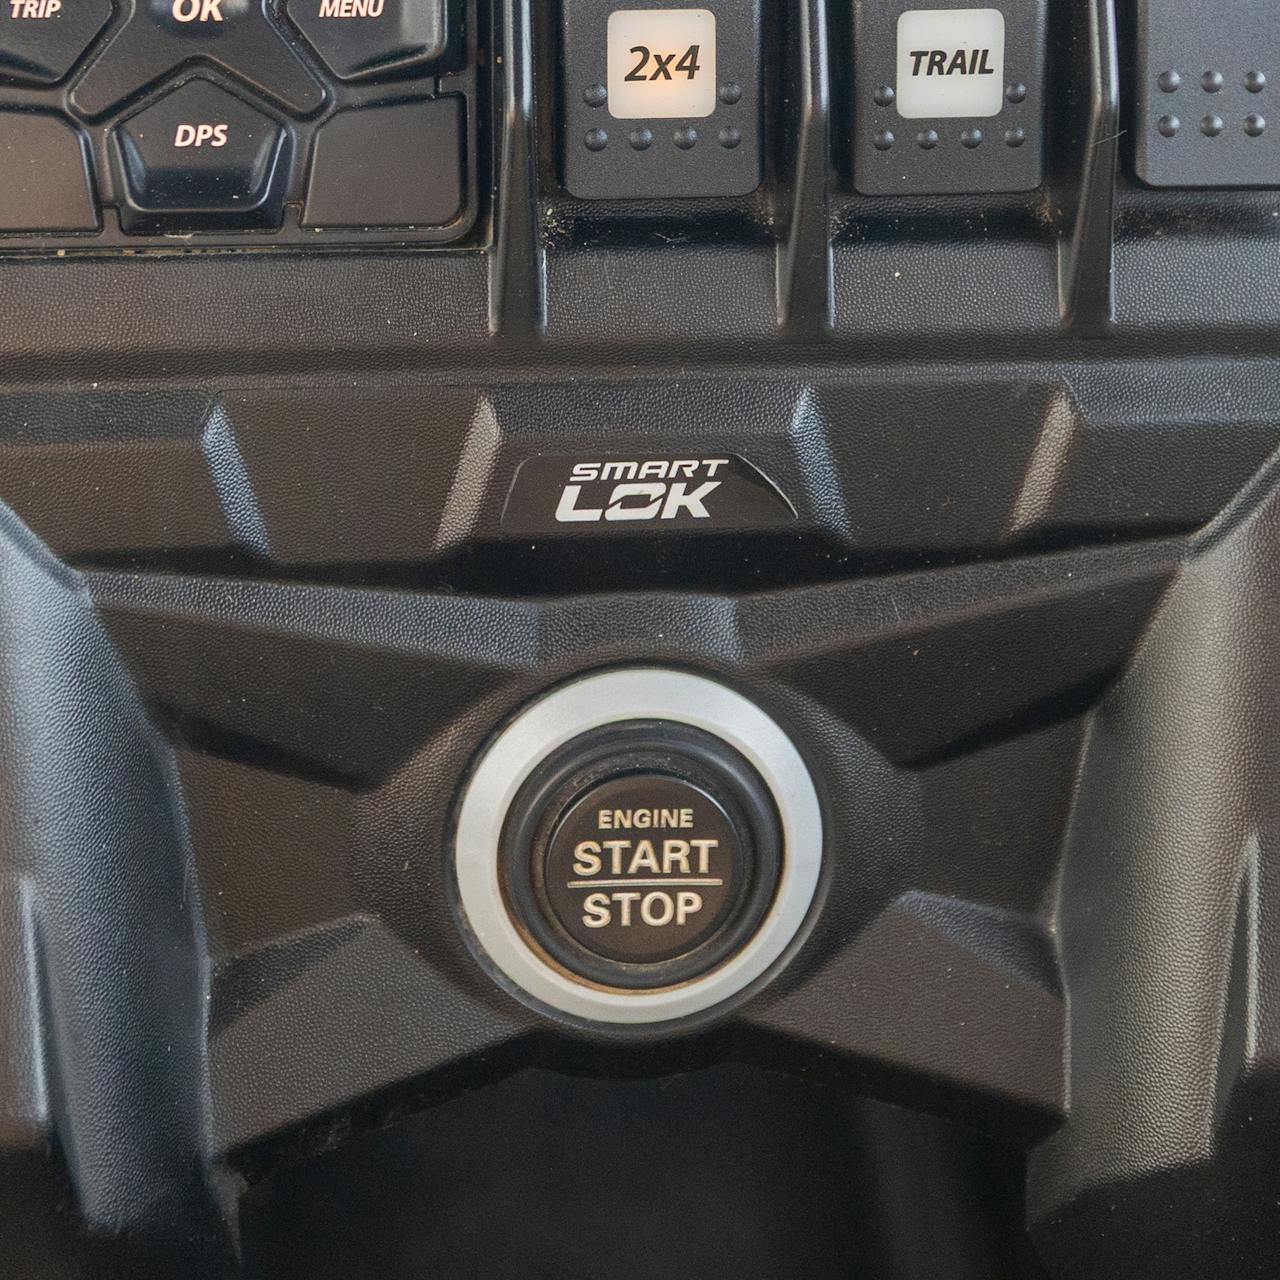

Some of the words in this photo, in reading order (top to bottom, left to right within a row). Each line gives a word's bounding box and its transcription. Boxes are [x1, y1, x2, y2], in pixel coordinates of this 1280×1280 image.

[10, 0, 61, 18] TRIP
[624, 45, 701, 83] 2x4
[909, 50, 995, 76] TRAIL
[174, 125, 228, 147] DPS
[569, 459, 729, 482] SMART
[555, 481, 722, 521] LOK
[598, 809, 694, 829] ENGINE
[573, 840, 718, 876] START
[582, 892, 703, 927] STOP
